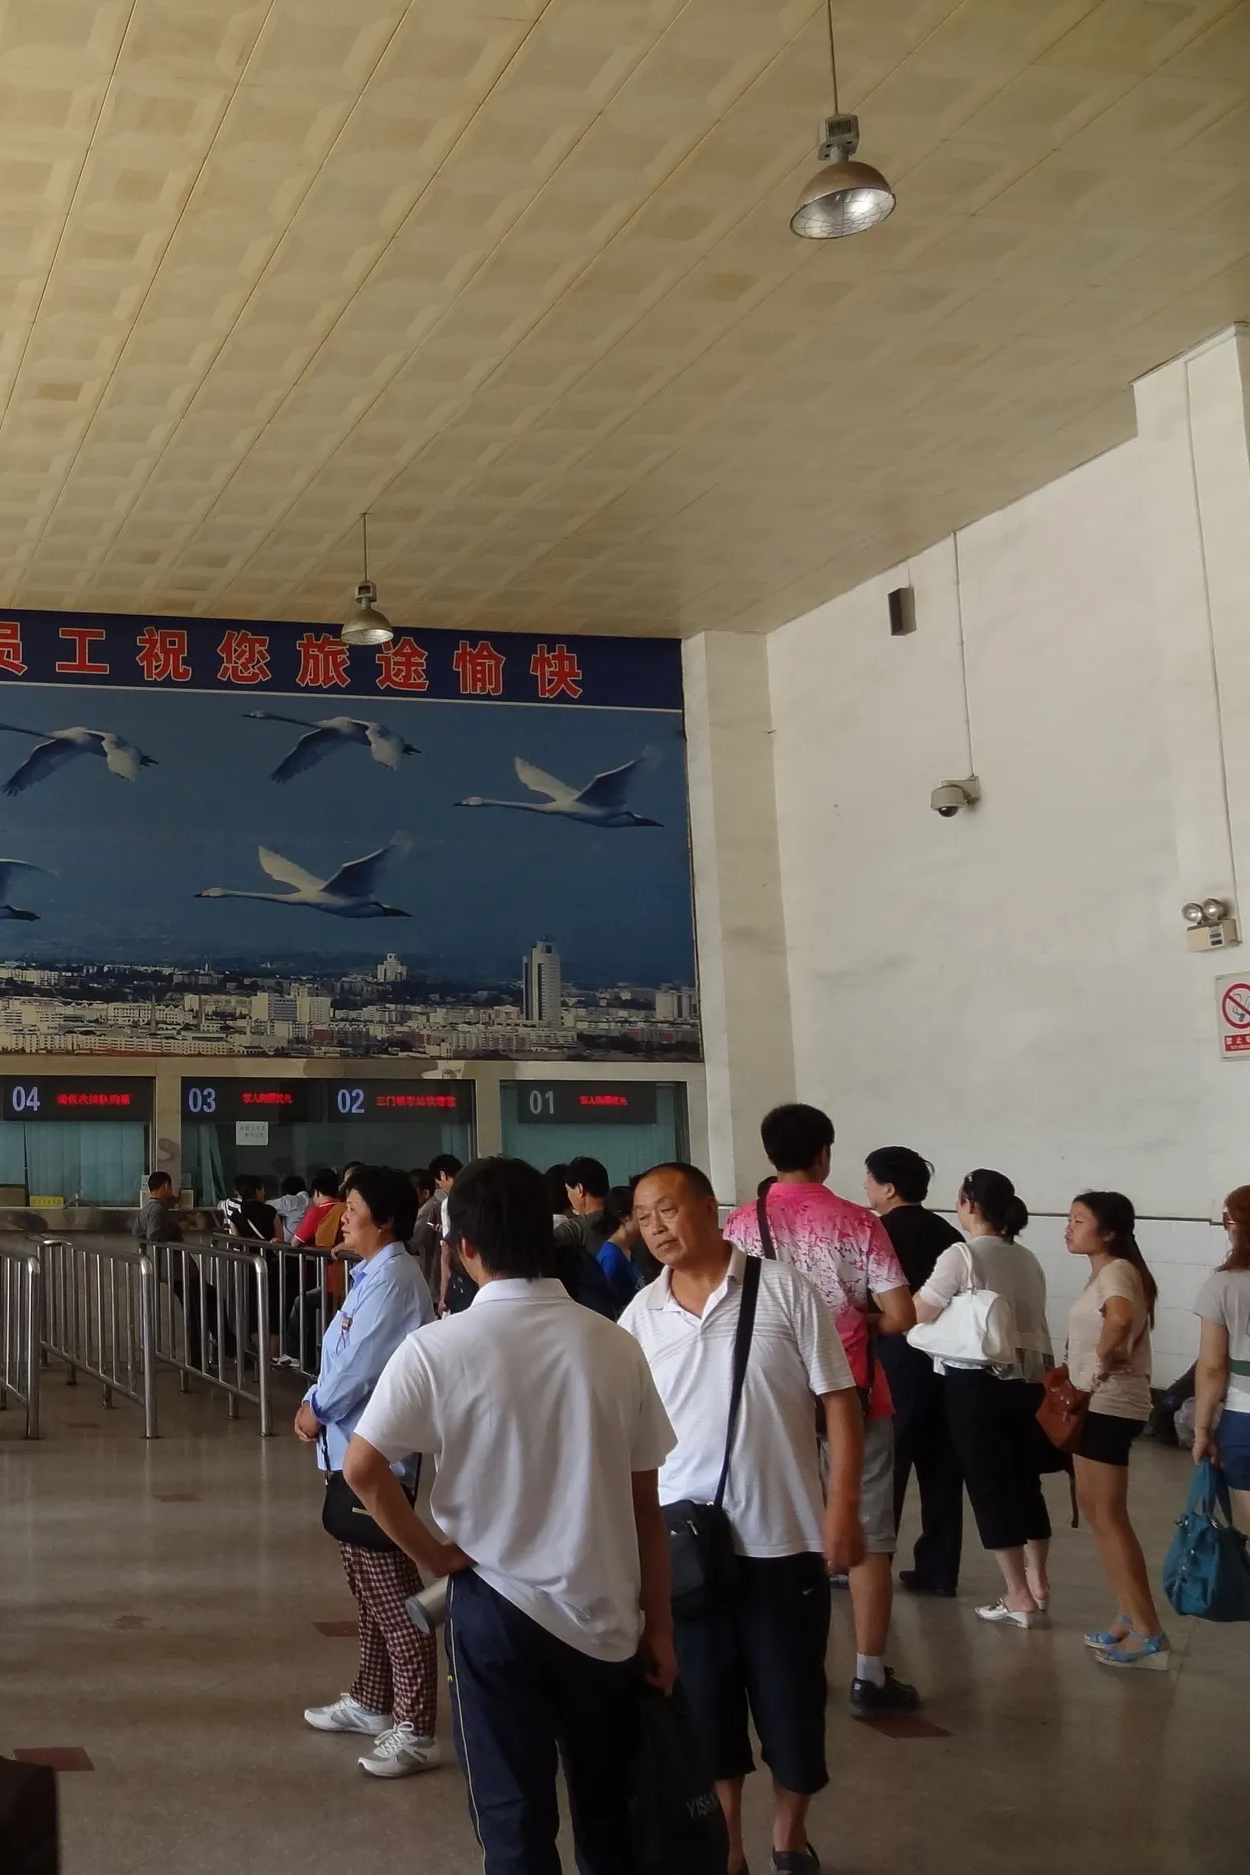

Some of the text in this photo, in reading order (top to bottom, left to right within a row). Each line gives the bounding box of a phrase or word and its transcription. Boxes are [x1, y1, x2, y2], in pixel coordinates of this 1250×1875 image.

[12, 1086, 41, 1112] 04
[188, 1087, 217, 1113] 03
[337, 1088, 365, 1114] 02
[529, 1090, 555, 1115] 01
